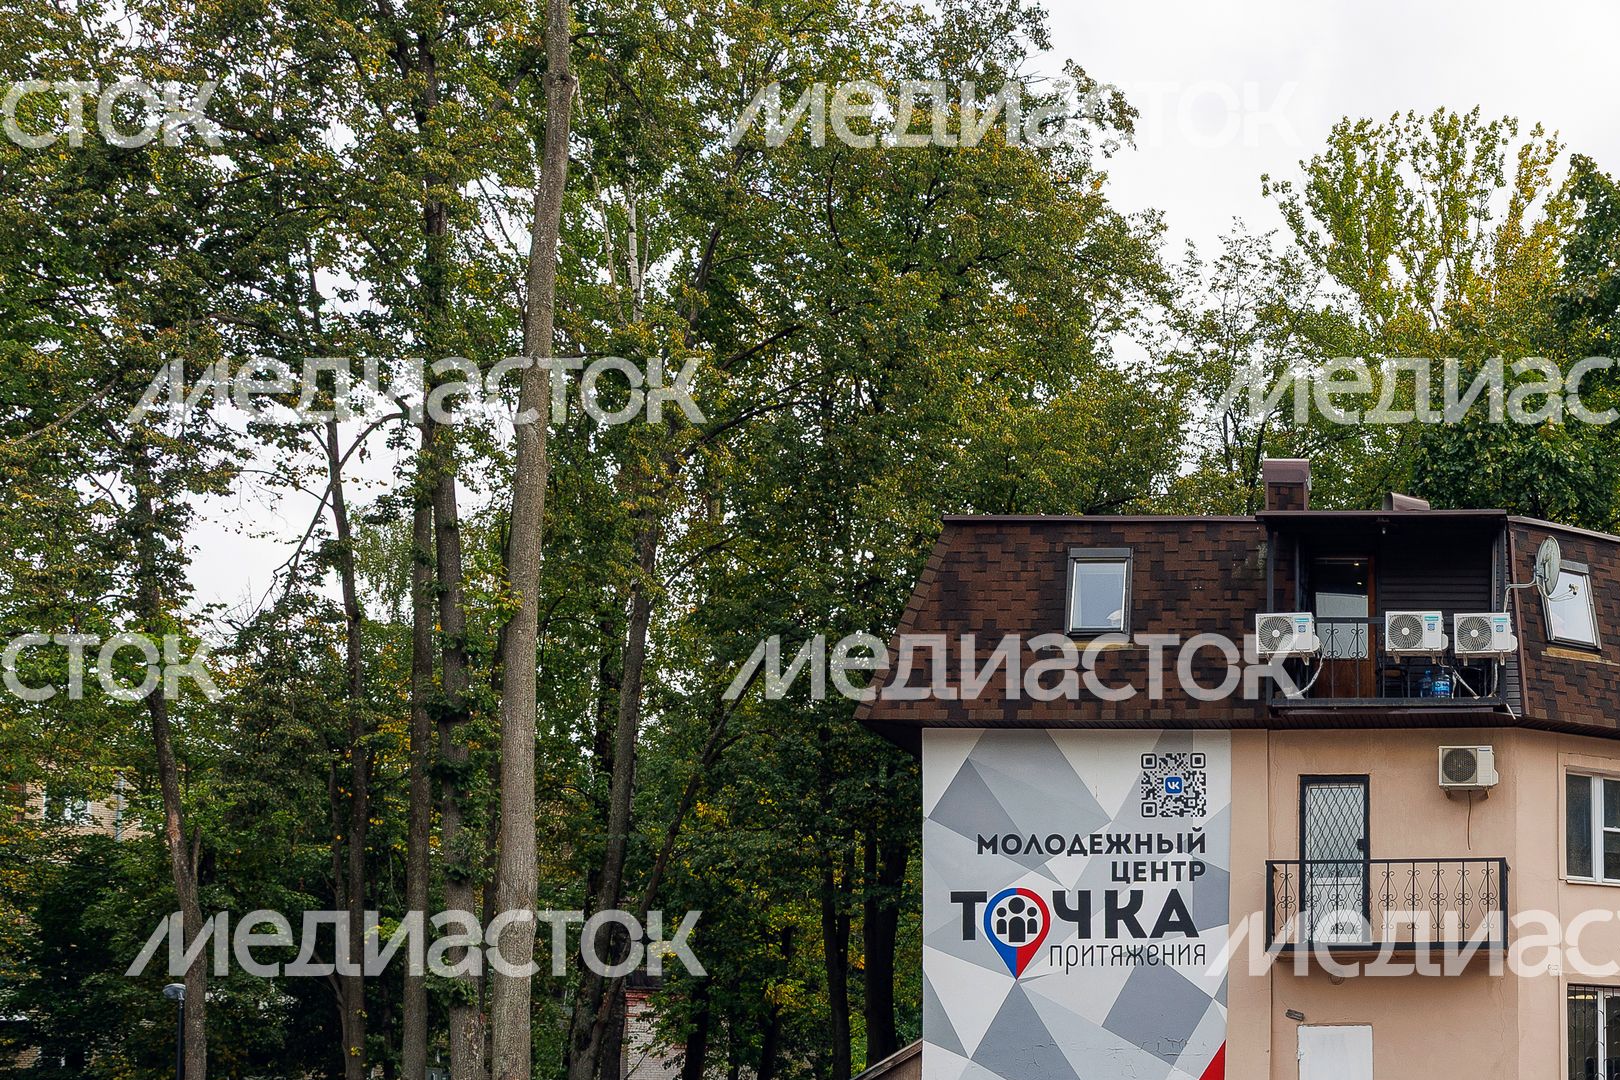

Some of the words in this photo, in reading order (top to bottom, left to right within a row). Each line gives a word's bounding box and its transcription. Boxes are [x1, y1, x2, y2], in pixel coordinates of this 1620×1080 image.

[977, 826, 1206, 857] МОЛОДЕЖНЫЙ
[1111, 861, 1206, 884] ЦЕНТР
[1049, 944, 1206, 975] притяжения
